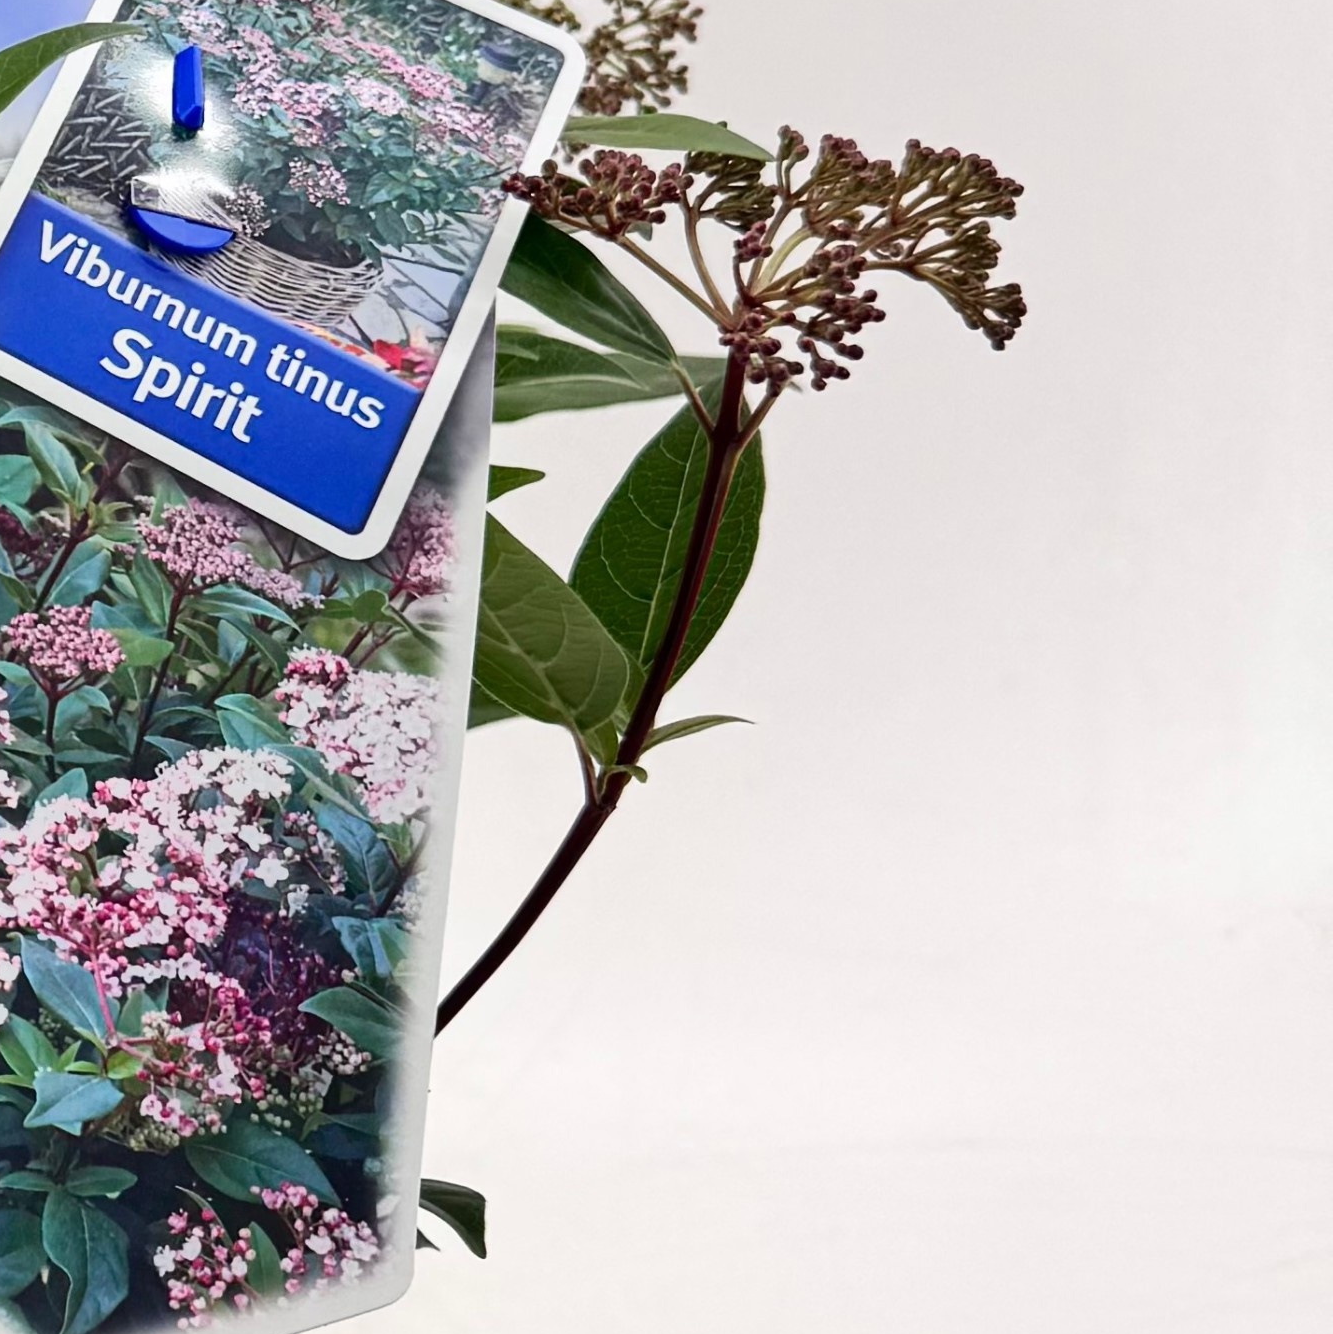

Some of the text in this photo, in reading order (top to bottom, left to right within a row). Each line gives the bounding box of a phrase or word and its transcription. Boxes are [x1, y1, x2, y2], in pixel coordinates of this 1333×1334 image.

[39, 219, 385, 429] Viburnum tinus
[99, 328, 263, 444] Spirit
